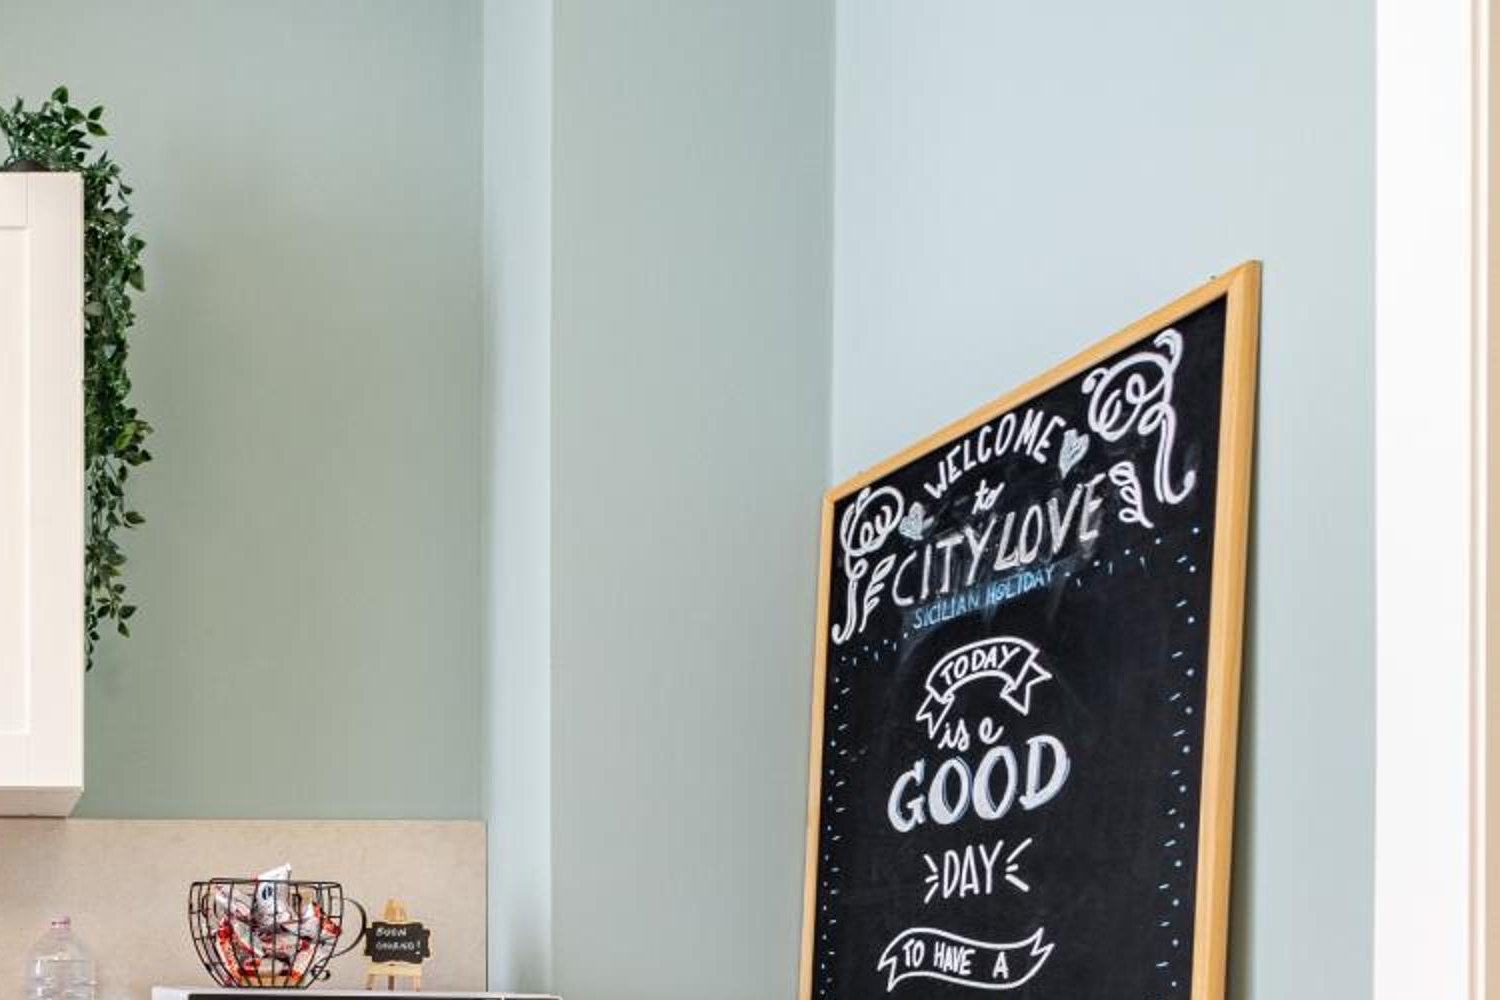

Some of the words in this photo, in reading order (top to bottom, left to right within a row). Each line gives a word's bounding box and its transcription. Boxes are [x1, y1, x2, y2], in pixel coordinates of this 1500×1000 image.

[924, 408, 1066, 499] WELCOME
[971, 479, 1005, 514] to
[940, 645, 1022, 686] TODAY
[937, 717, 971, 752] is
[887, 734, 1071, 832] GOOD
[943, 840, 1004, 899] DAY
[902, 938, 926, 969] TO
[933, 940, 976, 976] HAVE
[991, 951, 1010, 980] A
